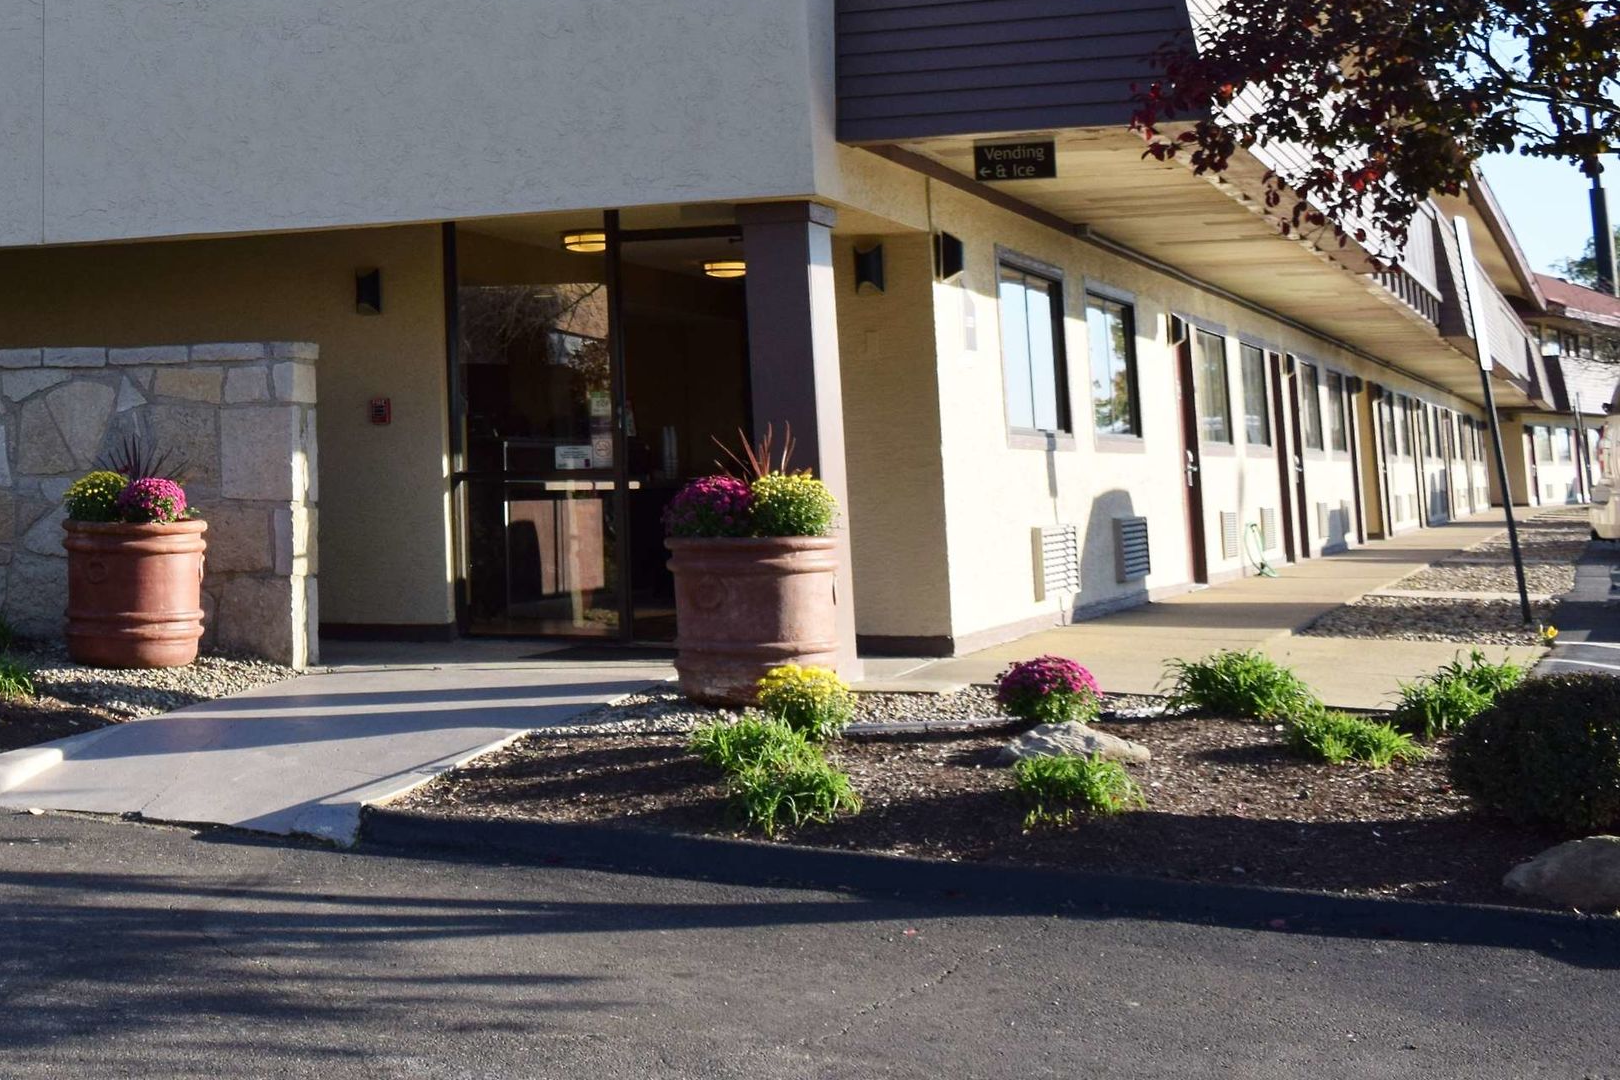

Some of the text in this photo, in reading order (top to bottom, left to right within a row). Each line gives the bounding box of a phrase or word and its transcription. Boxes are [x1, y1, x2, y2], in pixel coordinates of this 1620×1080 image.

[983, 145, 1045, 161] Vending
[995, 163, 1036, 178] & Ice
